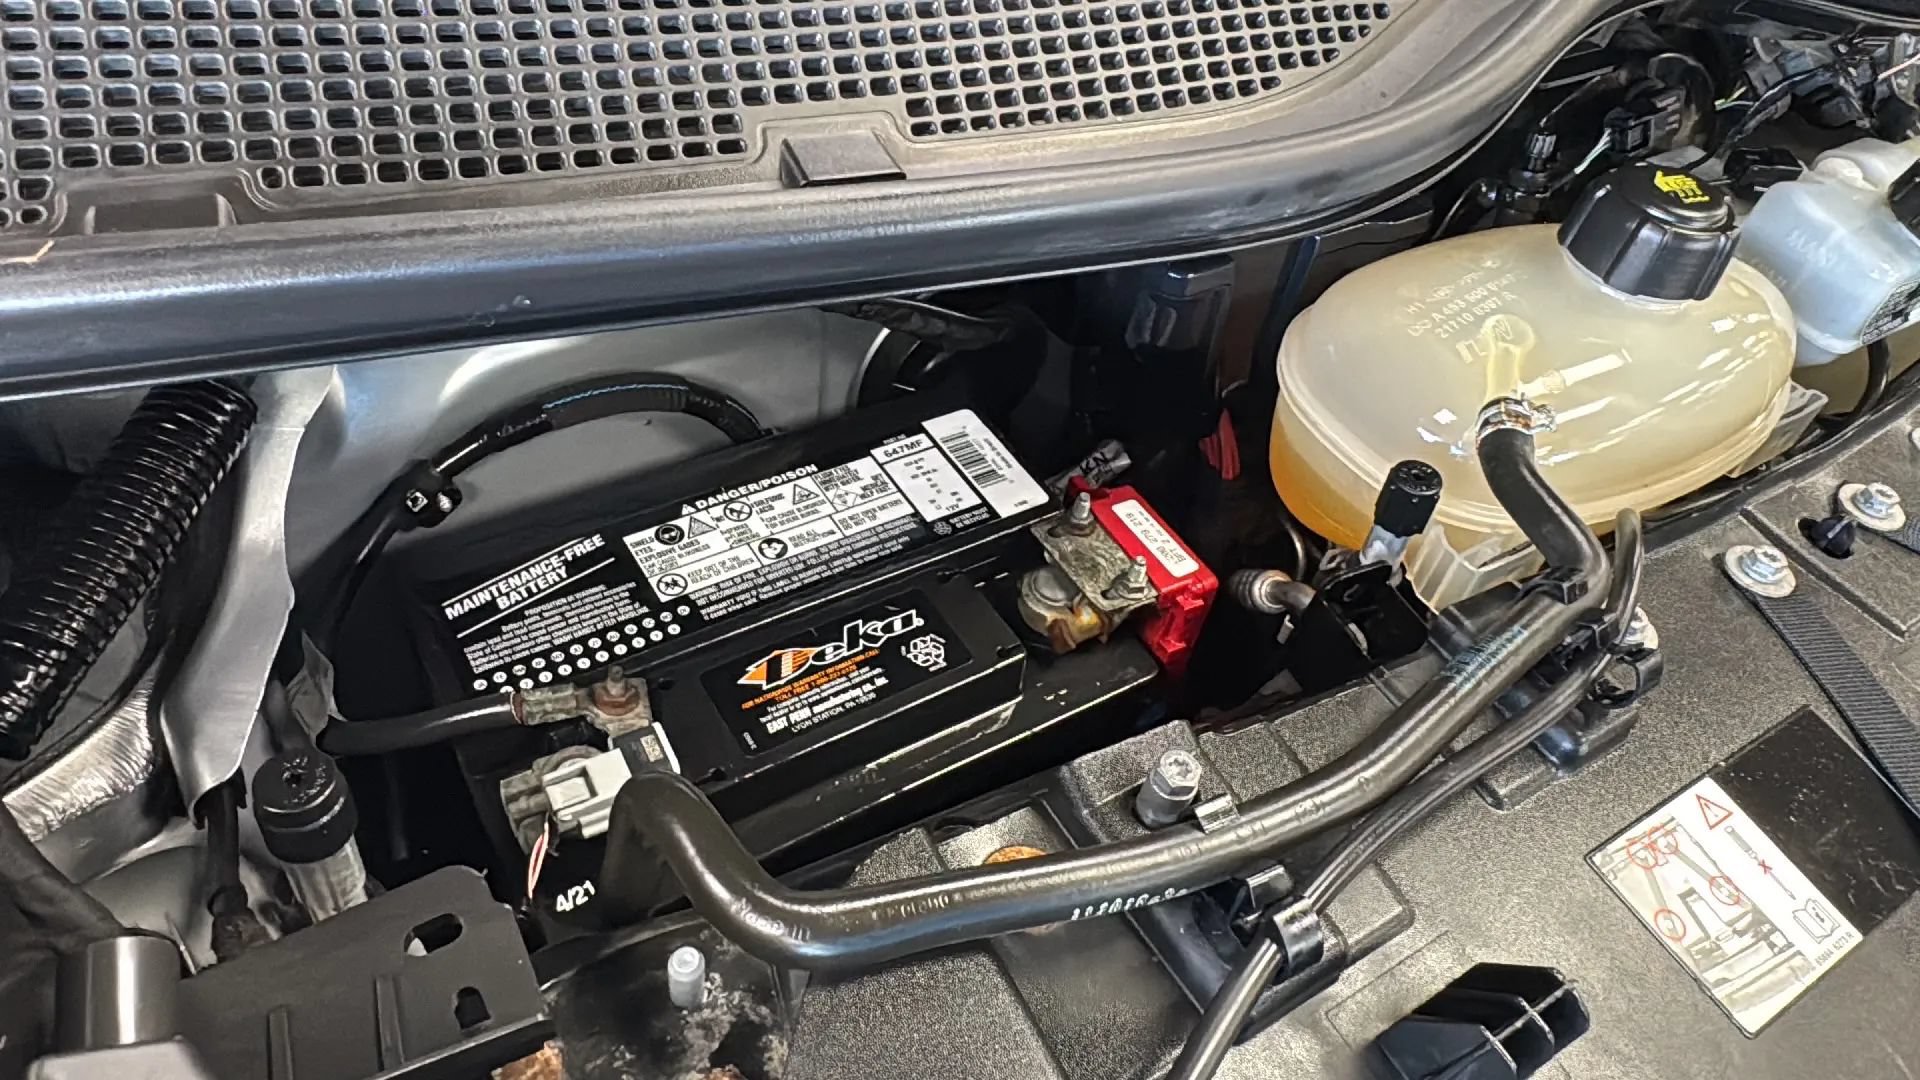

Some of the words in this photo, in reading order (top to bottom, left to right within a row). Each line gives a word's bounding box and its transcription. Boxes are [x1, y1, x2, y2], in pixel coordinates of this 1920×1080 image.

[883, 439, 922, 457] 647MF
[695, 464, 817, 508] DANGER/POISON
[444, 535, 606, 620] MAINTENANCE-FREE
[495, 566, 570, 611] BATTERY
[737, 608, 918, 691] Deka
[766, 716, 788, 733] EAST
[788, 706, 811, 723] PENN
[812, 687, 865, 716] manufacturing
[791, 719, 812, 732] LYON
[556, 880, 595, 912] 4/21
